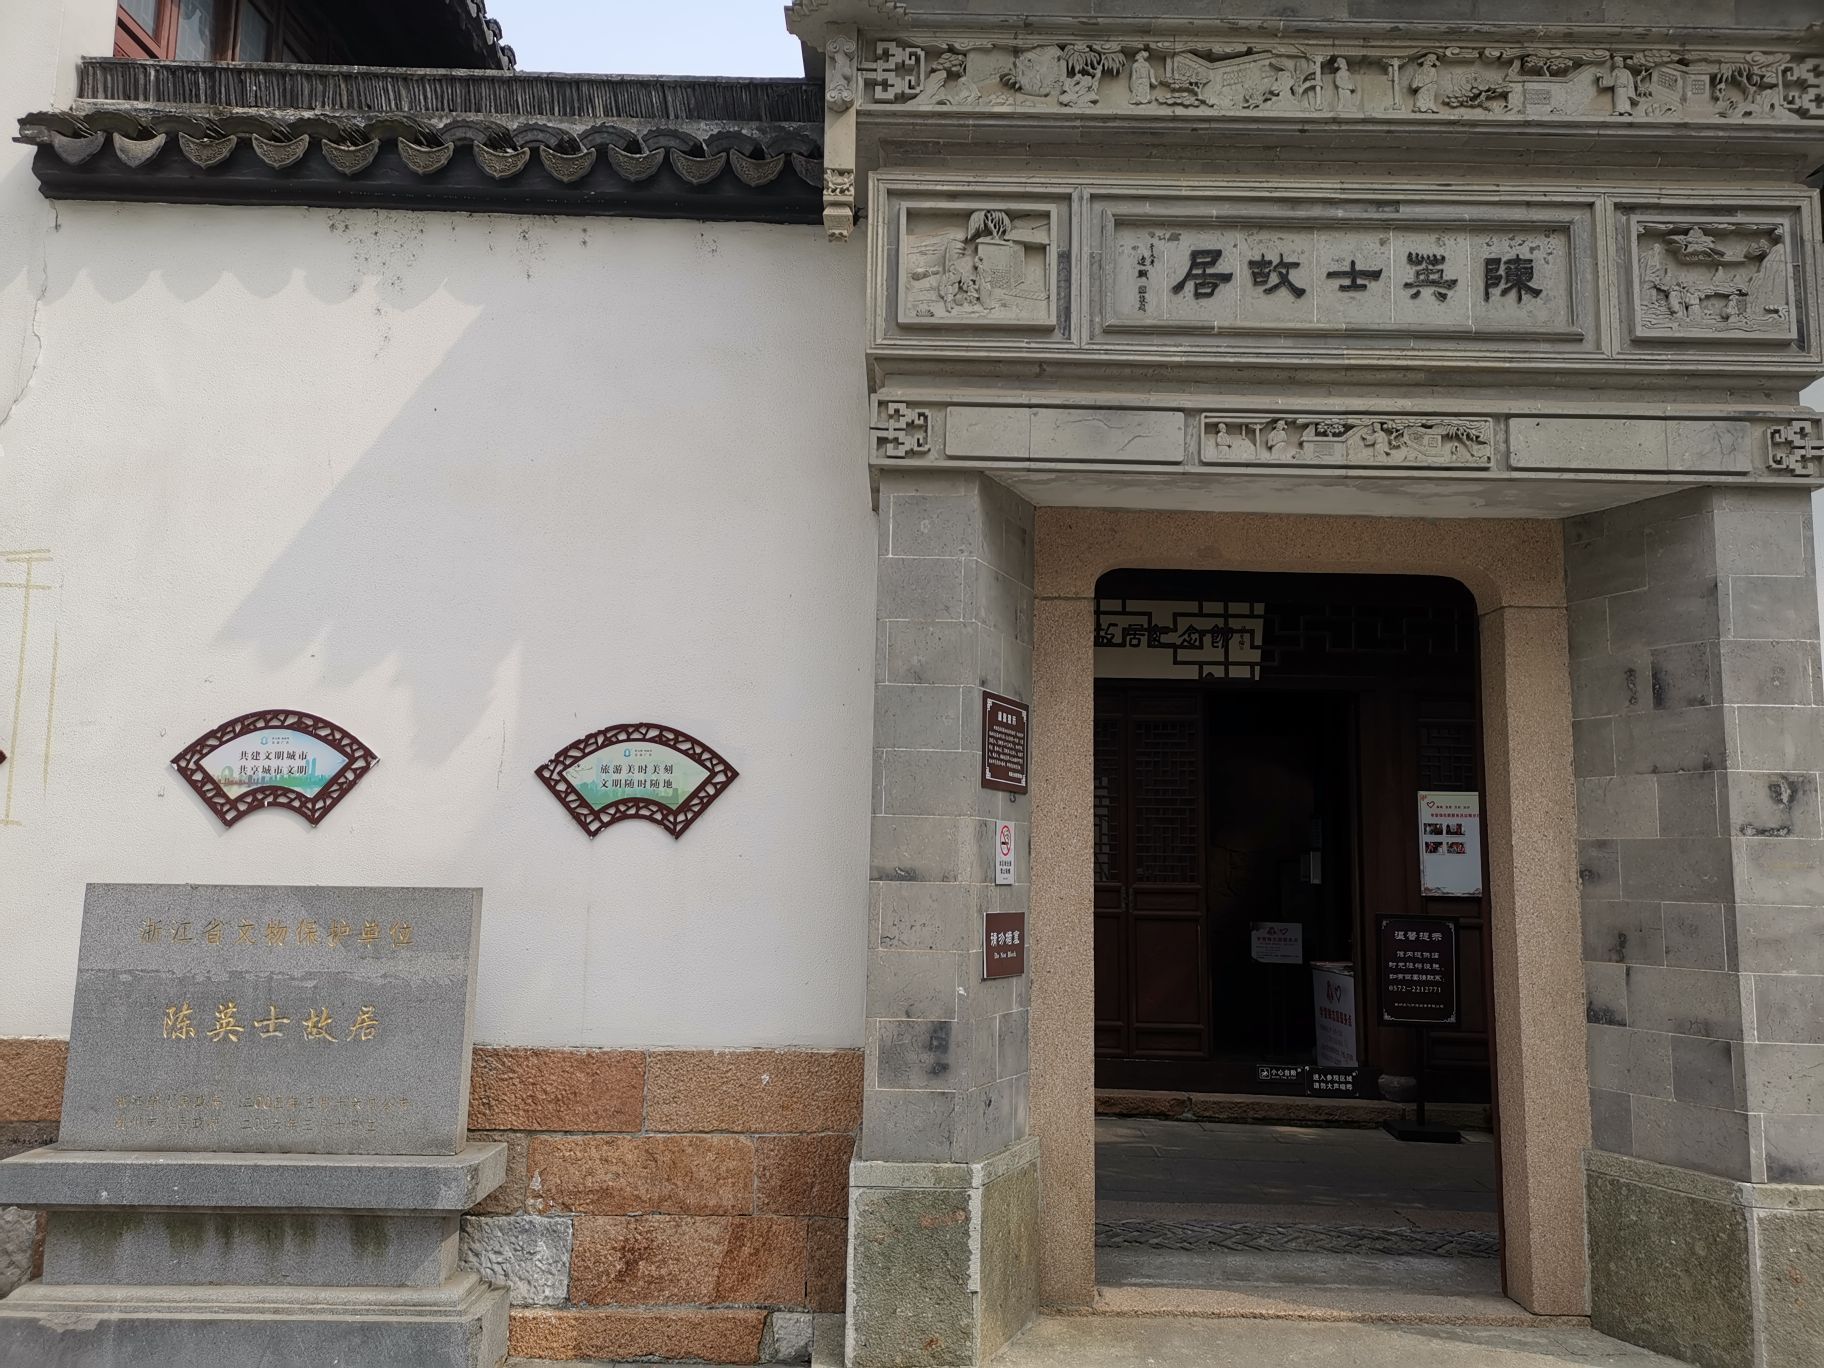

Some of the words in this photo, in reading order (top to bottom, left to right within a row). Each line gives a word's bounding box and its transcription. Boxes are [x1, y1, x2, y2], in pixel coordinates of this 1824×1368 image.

[239, 750, 308, 761] 共建文明城市
[239, 764, 307, 775] 共享城市文明
[599, 764, 674, 775] 旅游美时美刻
[600, 778, 673, 789] 文明随时随地
[138, 917, 414, 948] 浙江省文物保护单位
[161, 1000, 382, 1044] 陈英士故居
[1270, 1069, 1297, 1077] 小心台阶
[1312, 1073, 1352, 1082] 进入参观区域
